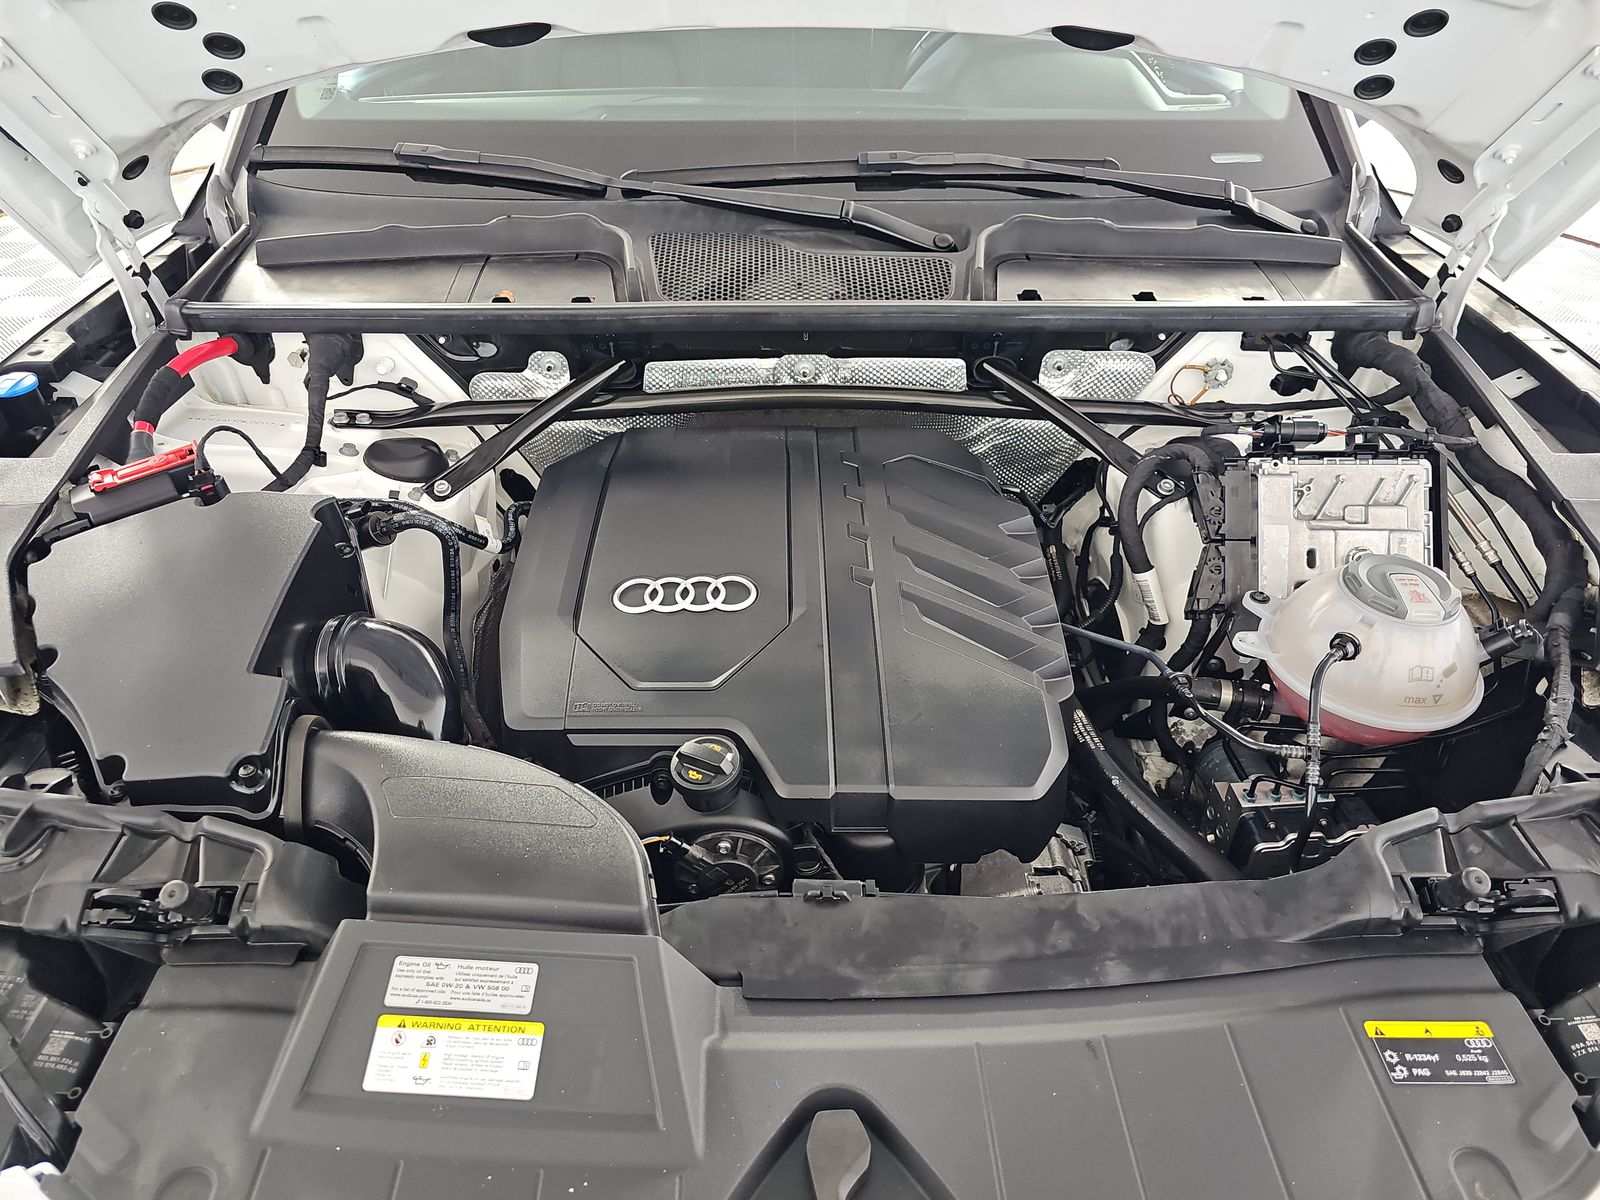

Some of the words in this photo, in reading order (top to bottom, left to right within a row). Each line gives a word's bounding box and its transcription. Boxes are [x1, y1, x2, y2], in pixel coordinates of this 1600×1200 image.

[1404, 696, 1428, 704] max
[398, 960, 421, 968] Engine
[411, 1020, 462, 1030] WARNING
[467, 1023, 526, 1034] ATTENTION
[1404, 1053, 1440, 1063] R-1234yf
[1455, 1054, 1478, 1063] 0,525
[1479, 1054, 1489, 1063] kg
[1411, 1068, 1432, 1077] PAG
